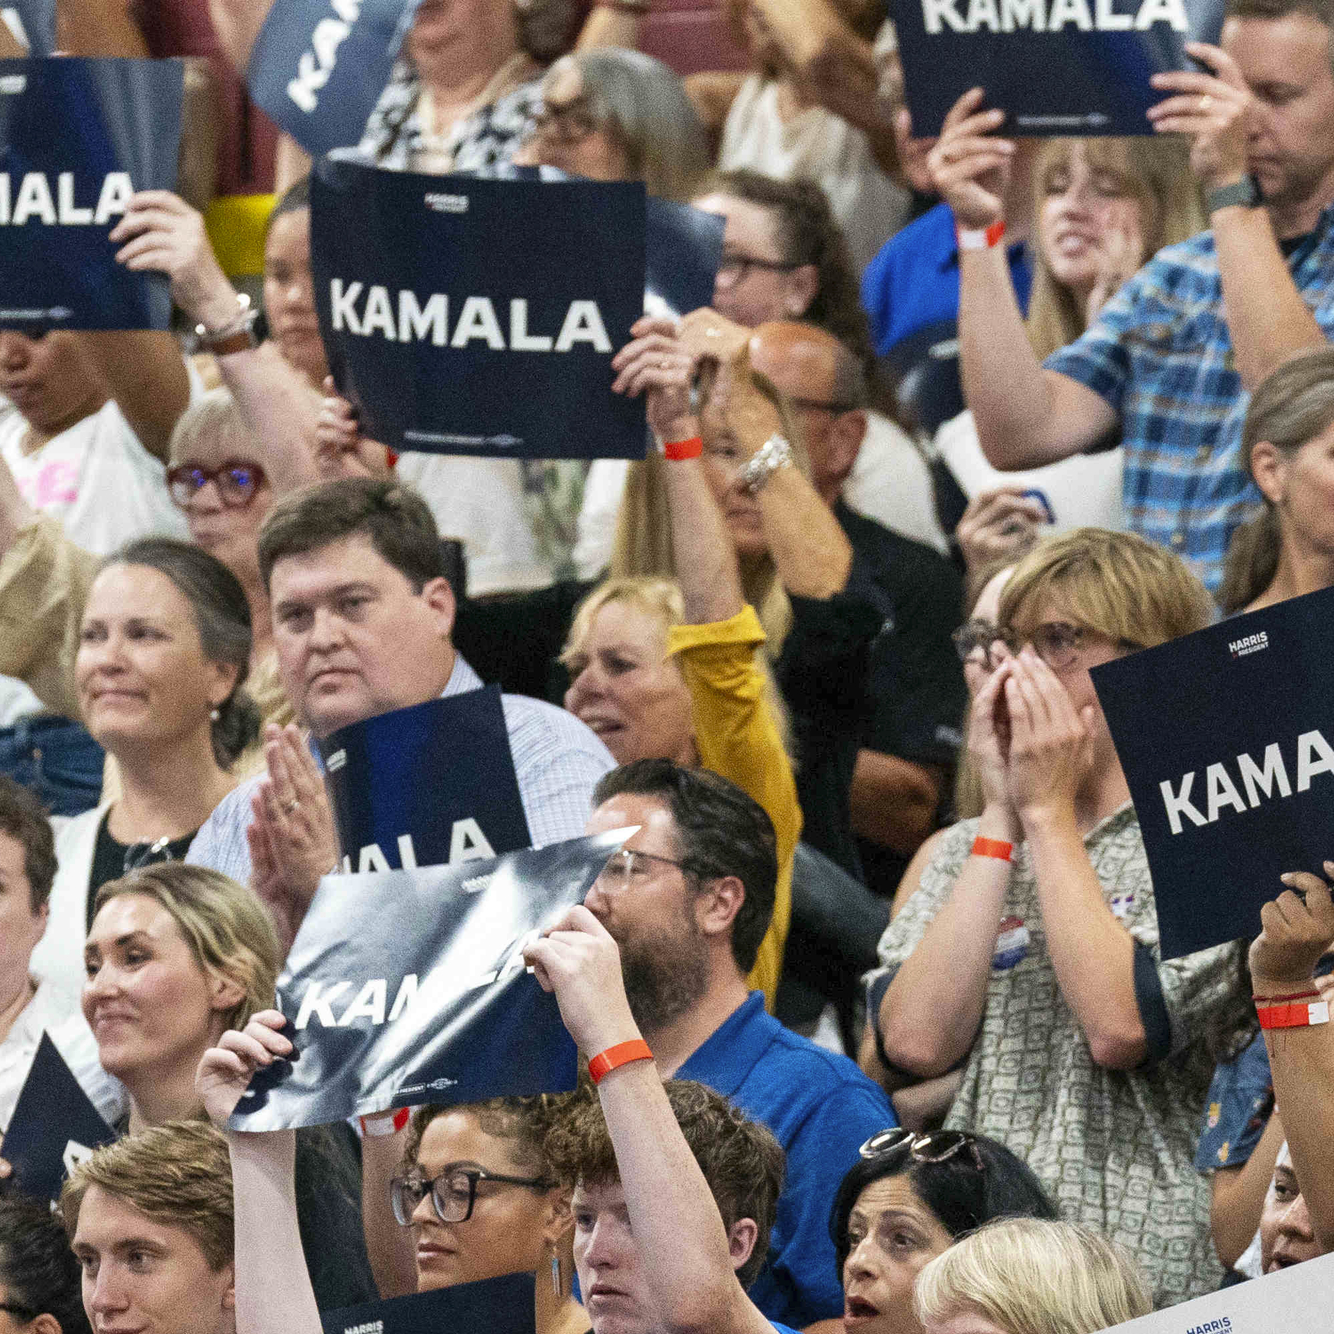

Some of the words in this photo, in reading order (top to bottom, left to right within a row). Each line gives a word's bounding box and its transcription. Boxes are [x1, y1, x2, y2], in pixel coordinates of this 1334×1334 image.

[330, 278, 612, 353] KAMALA
[1228, 631, 1268, 652] HARRIS
[342, 817, 496, 877] ALA
